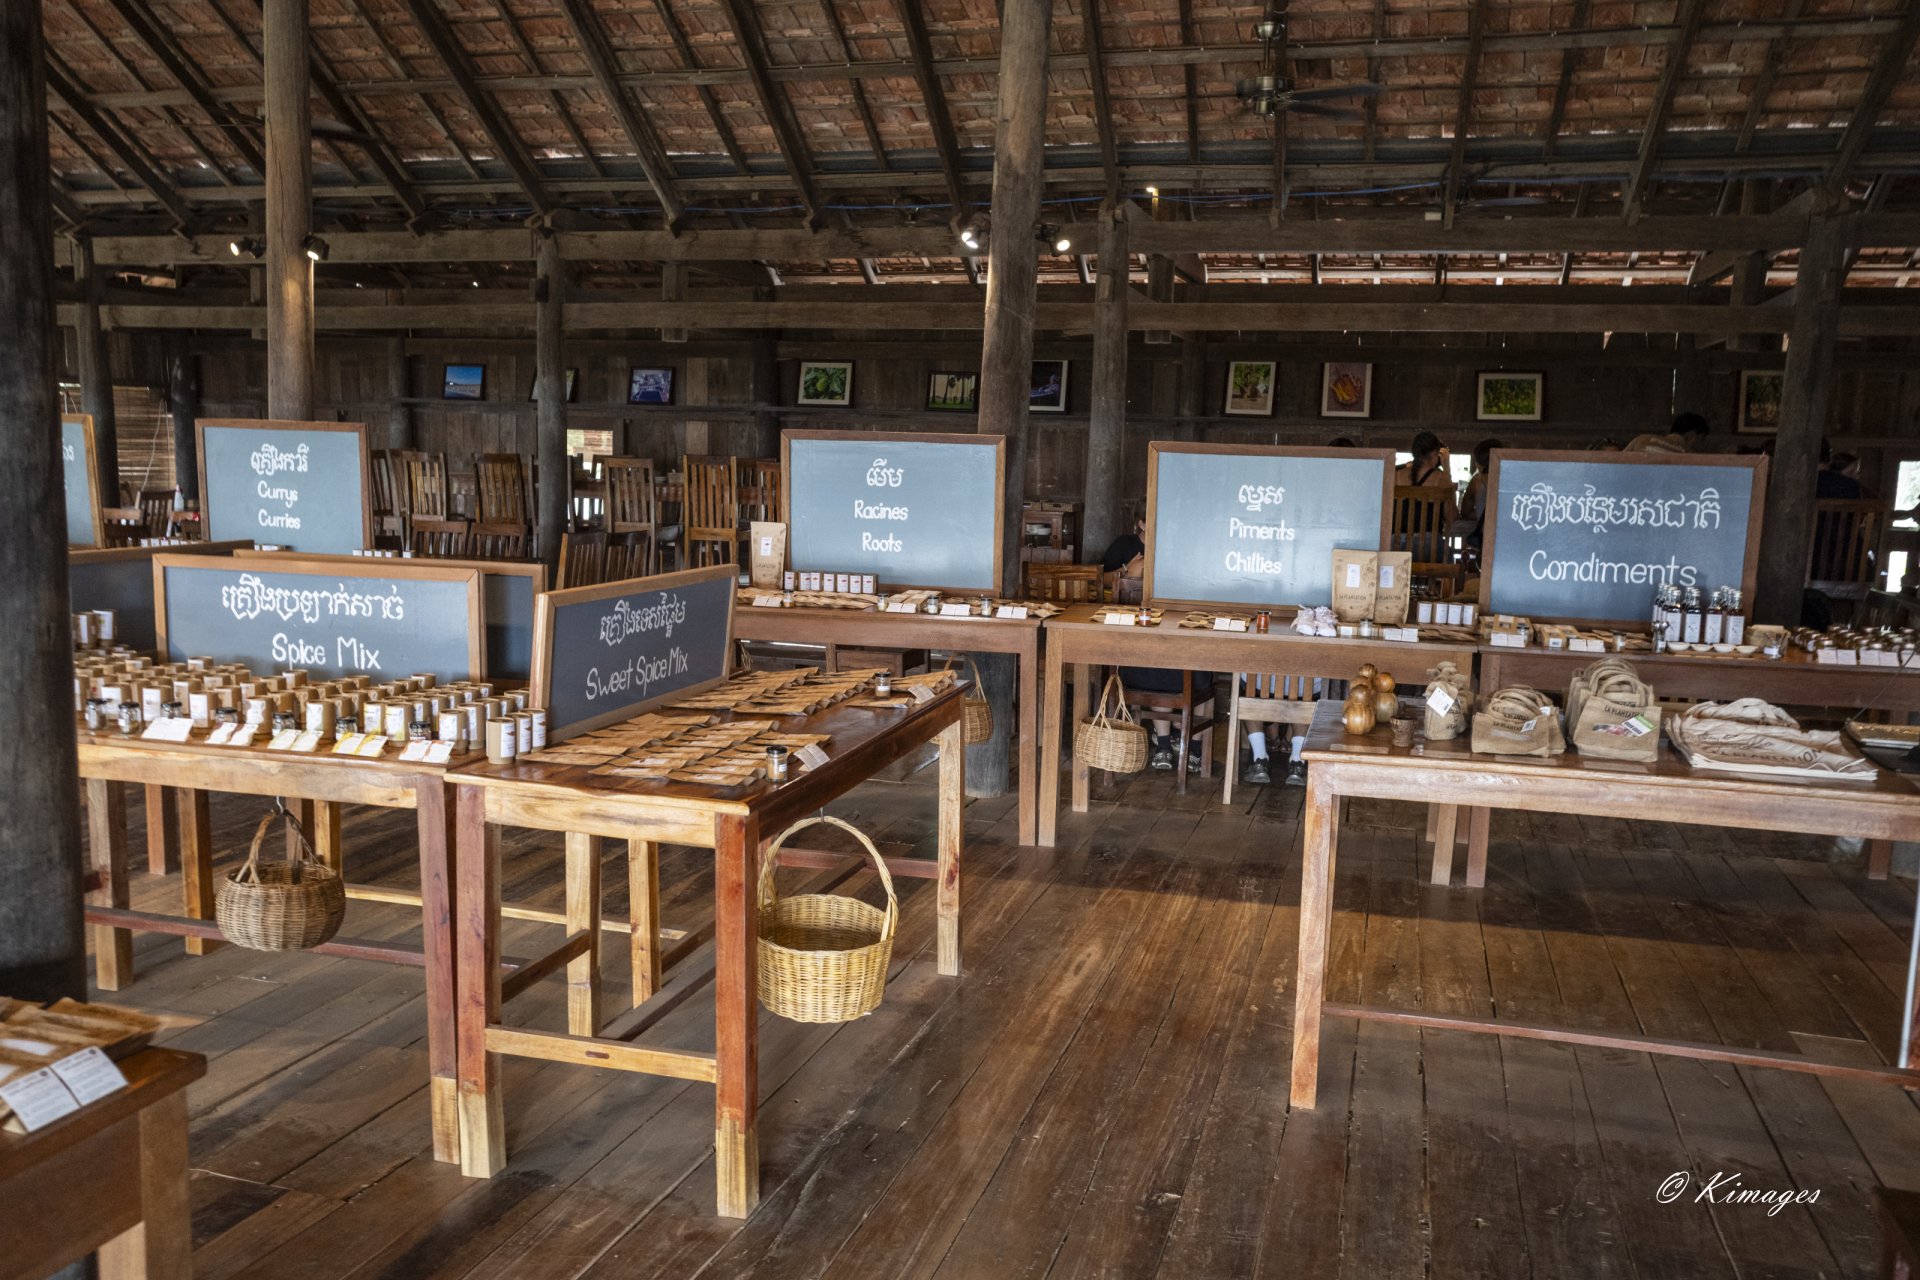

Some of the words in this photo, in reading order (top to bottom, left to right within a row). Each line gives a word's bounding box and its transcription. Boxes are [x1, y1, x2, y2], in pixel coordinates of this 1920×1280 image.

[257, 480, 299, 508] Currys
[258, 508, 301, 530] Curries
[854, 499, 909, 521] Racines
[1229, 516, 1295, 541] Piments
[862, 532, 903, 552] Roots
[1225, 551, 1282, 574] Chillies
[1529, 550, 1698, 587] Condiments
[272, 633, 326, 670] Spice
[337, 636, 382, 670] Mix
[585, 658, 633, 700] Sweet
[636, 655, 668, 697] Spice
[668, 646, 688, 677] Mix
